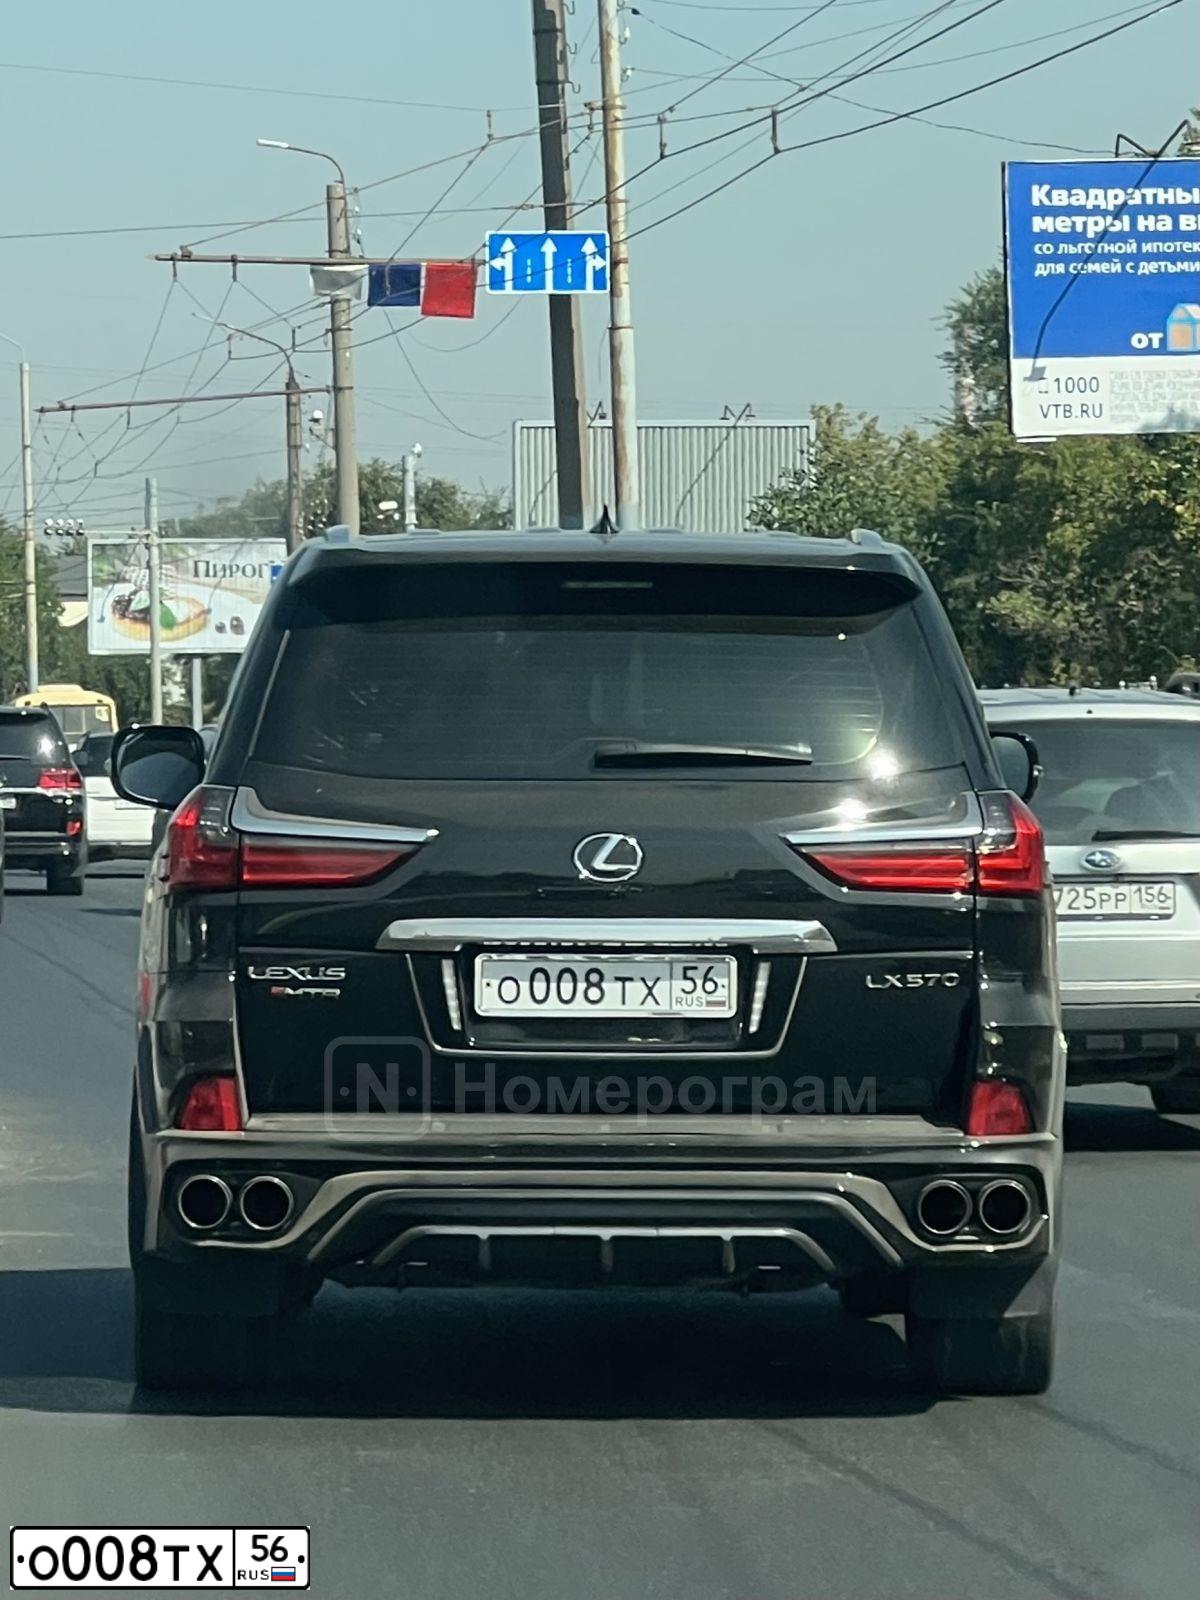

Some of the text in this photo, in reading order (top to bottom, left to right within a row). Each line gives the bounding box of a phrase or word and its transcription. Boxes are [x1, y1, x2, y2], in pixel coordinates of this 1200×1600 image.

[1031, 184, 1200, 211] Квадратны
[1031, 213, 1200, 239] метры на в
[1034, 243, 1054, 254] со
[1034, 259, 1200, 277] для семей с детьми
[1130, 333, 1164, 349] от
[1054, 376, 1100, 394] 1000
[1039, 403, 1103, 419] VTB.RU
[1133, 886, 1169, 904] 156
[247, 966, 346, 981] LEXUS
[680, 965, 719, 995] 56
[675, 996, 704, 1008] RUS
